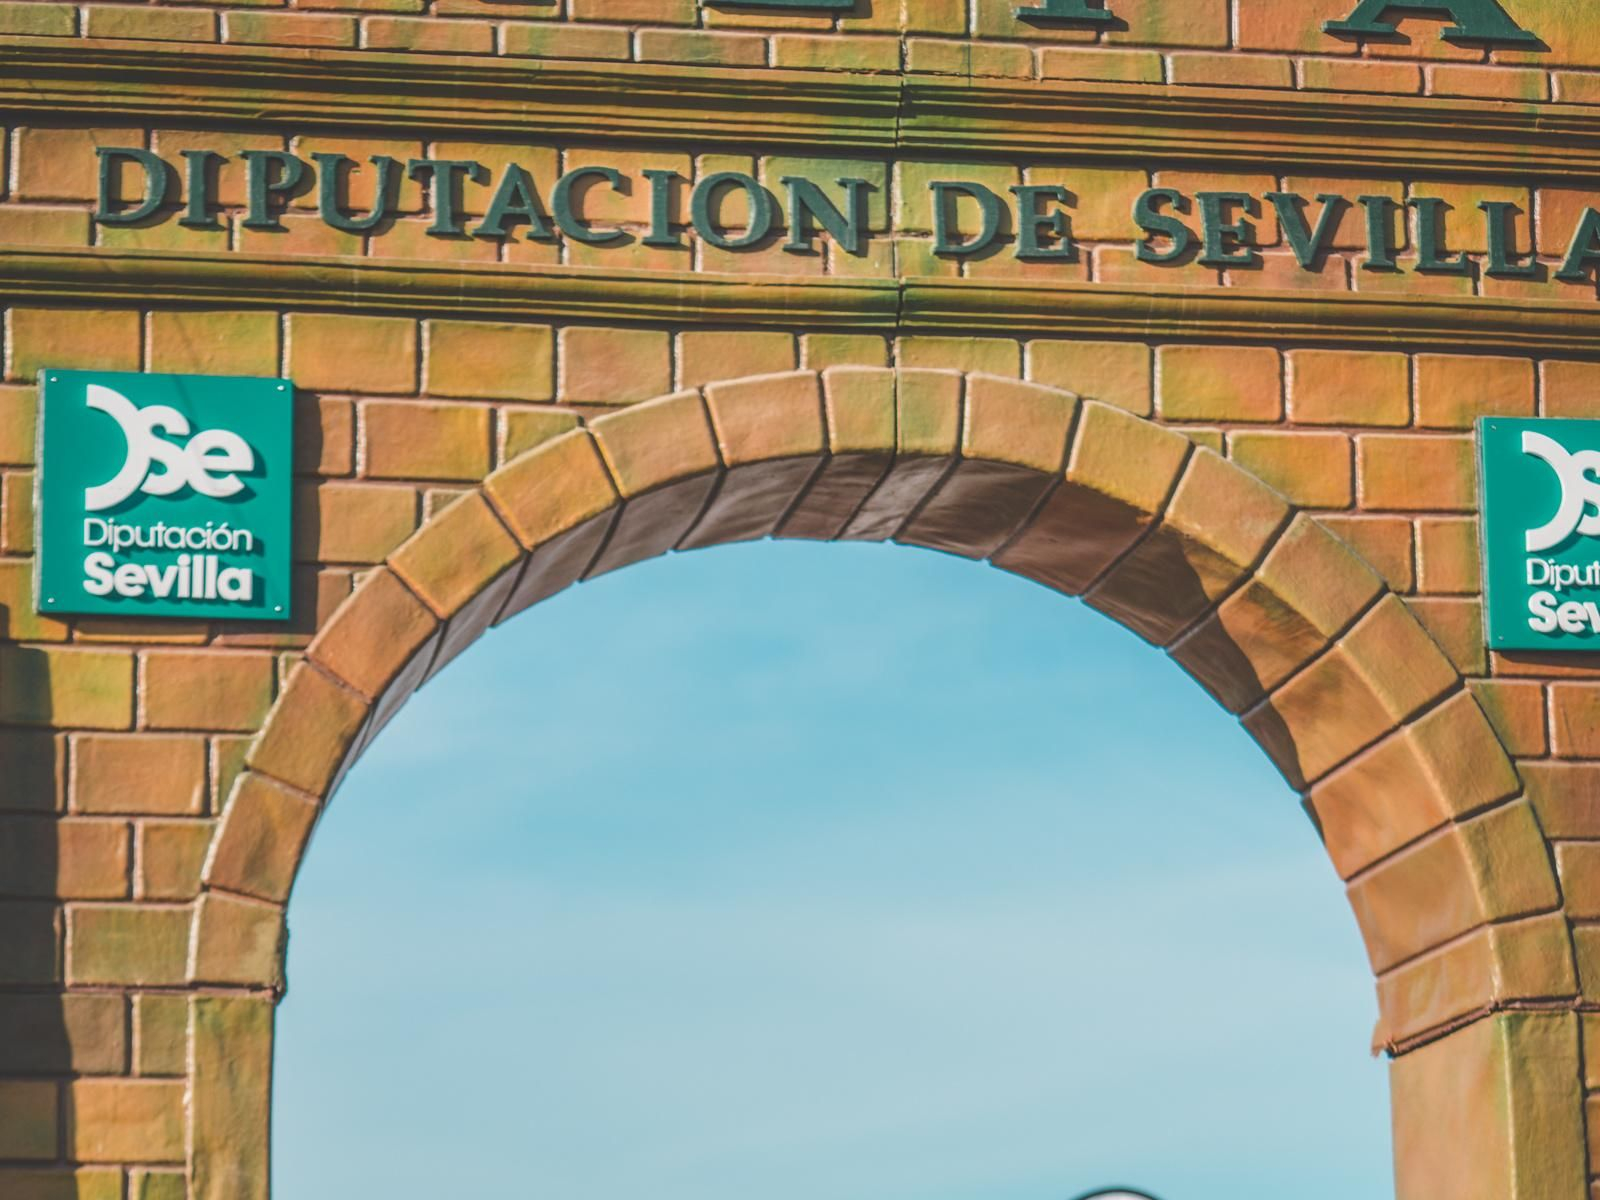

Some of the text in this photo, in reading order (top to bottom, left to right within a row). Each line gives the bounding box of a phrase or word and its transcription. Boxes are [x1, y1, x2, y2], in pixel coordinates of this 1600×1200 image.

[96, 147, 869, 254] DIPUTACION
[929, 180, 1075, 258] DE
[83, 517, 252, 552] Diputación
[83, 551, 252, 600] Sevilla
